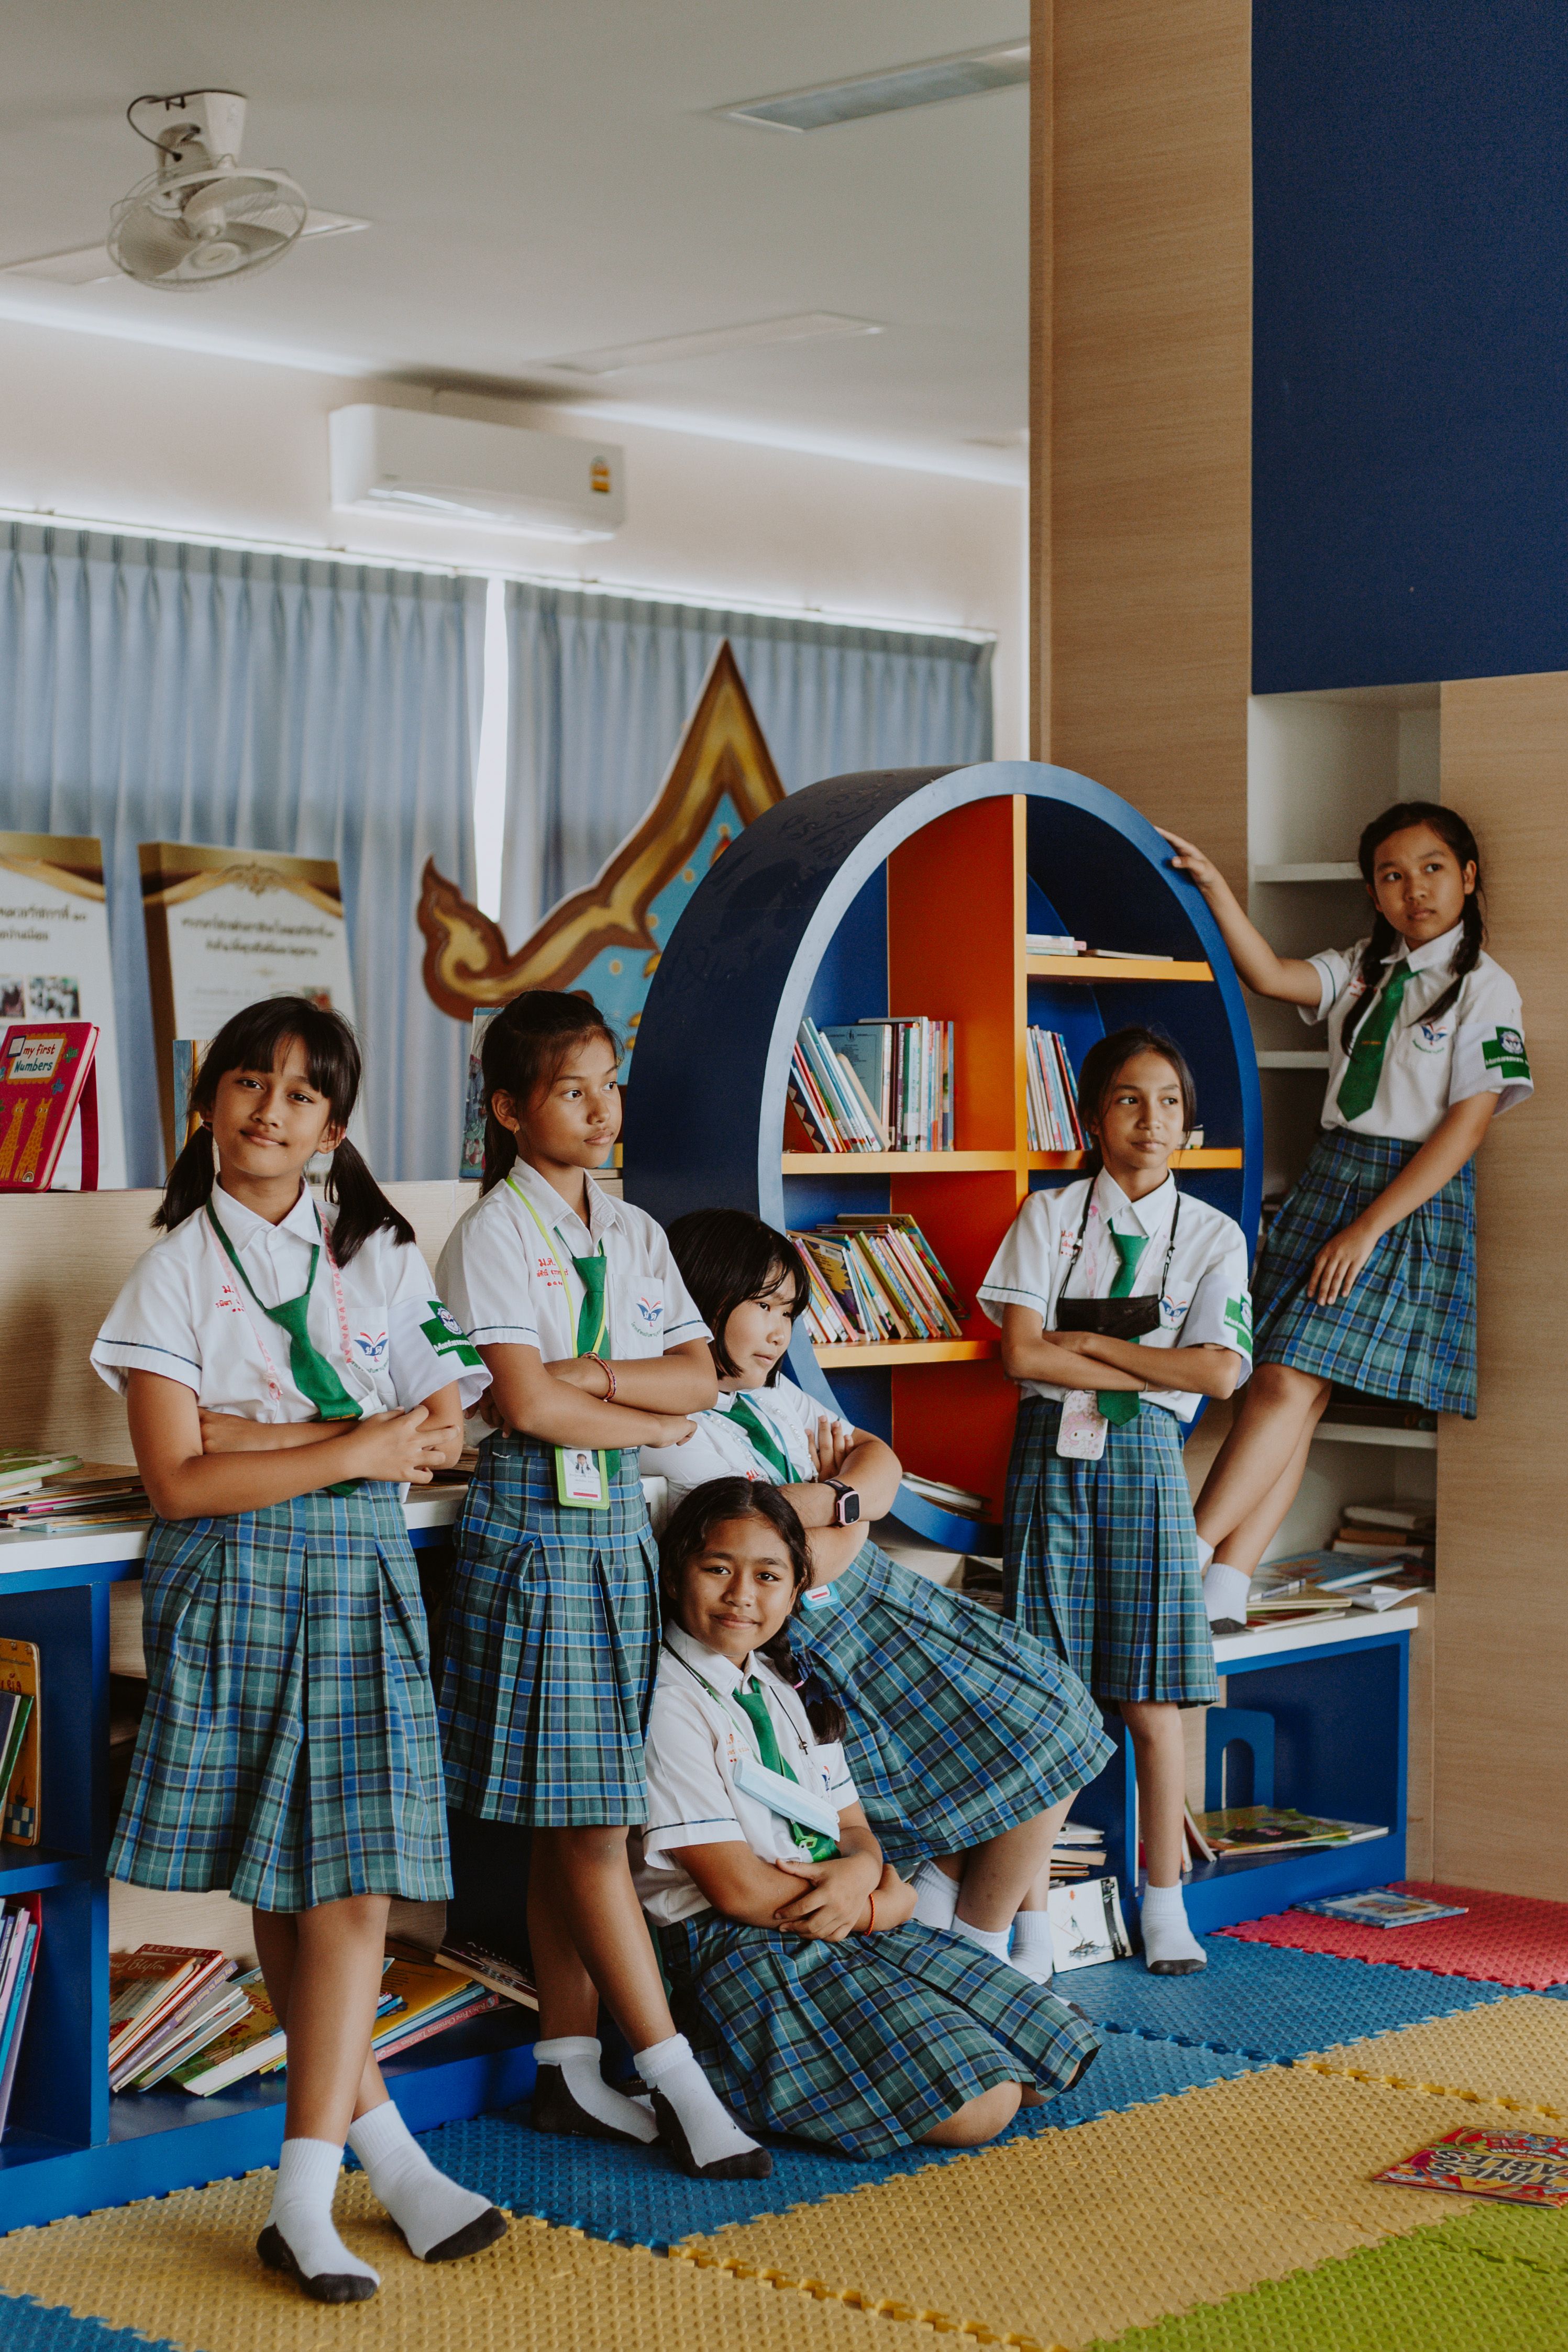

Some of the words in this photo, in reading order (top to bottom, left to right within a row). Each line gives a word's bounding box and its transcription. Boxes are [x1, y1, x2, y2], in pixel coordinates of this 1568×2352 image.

[23, 1047, 35, 1059] my
[36, 1043, 56, 1056] first
[14, 1058, 53, 1073] Numbers
[127, 1958, 166, 1974] Blyton
